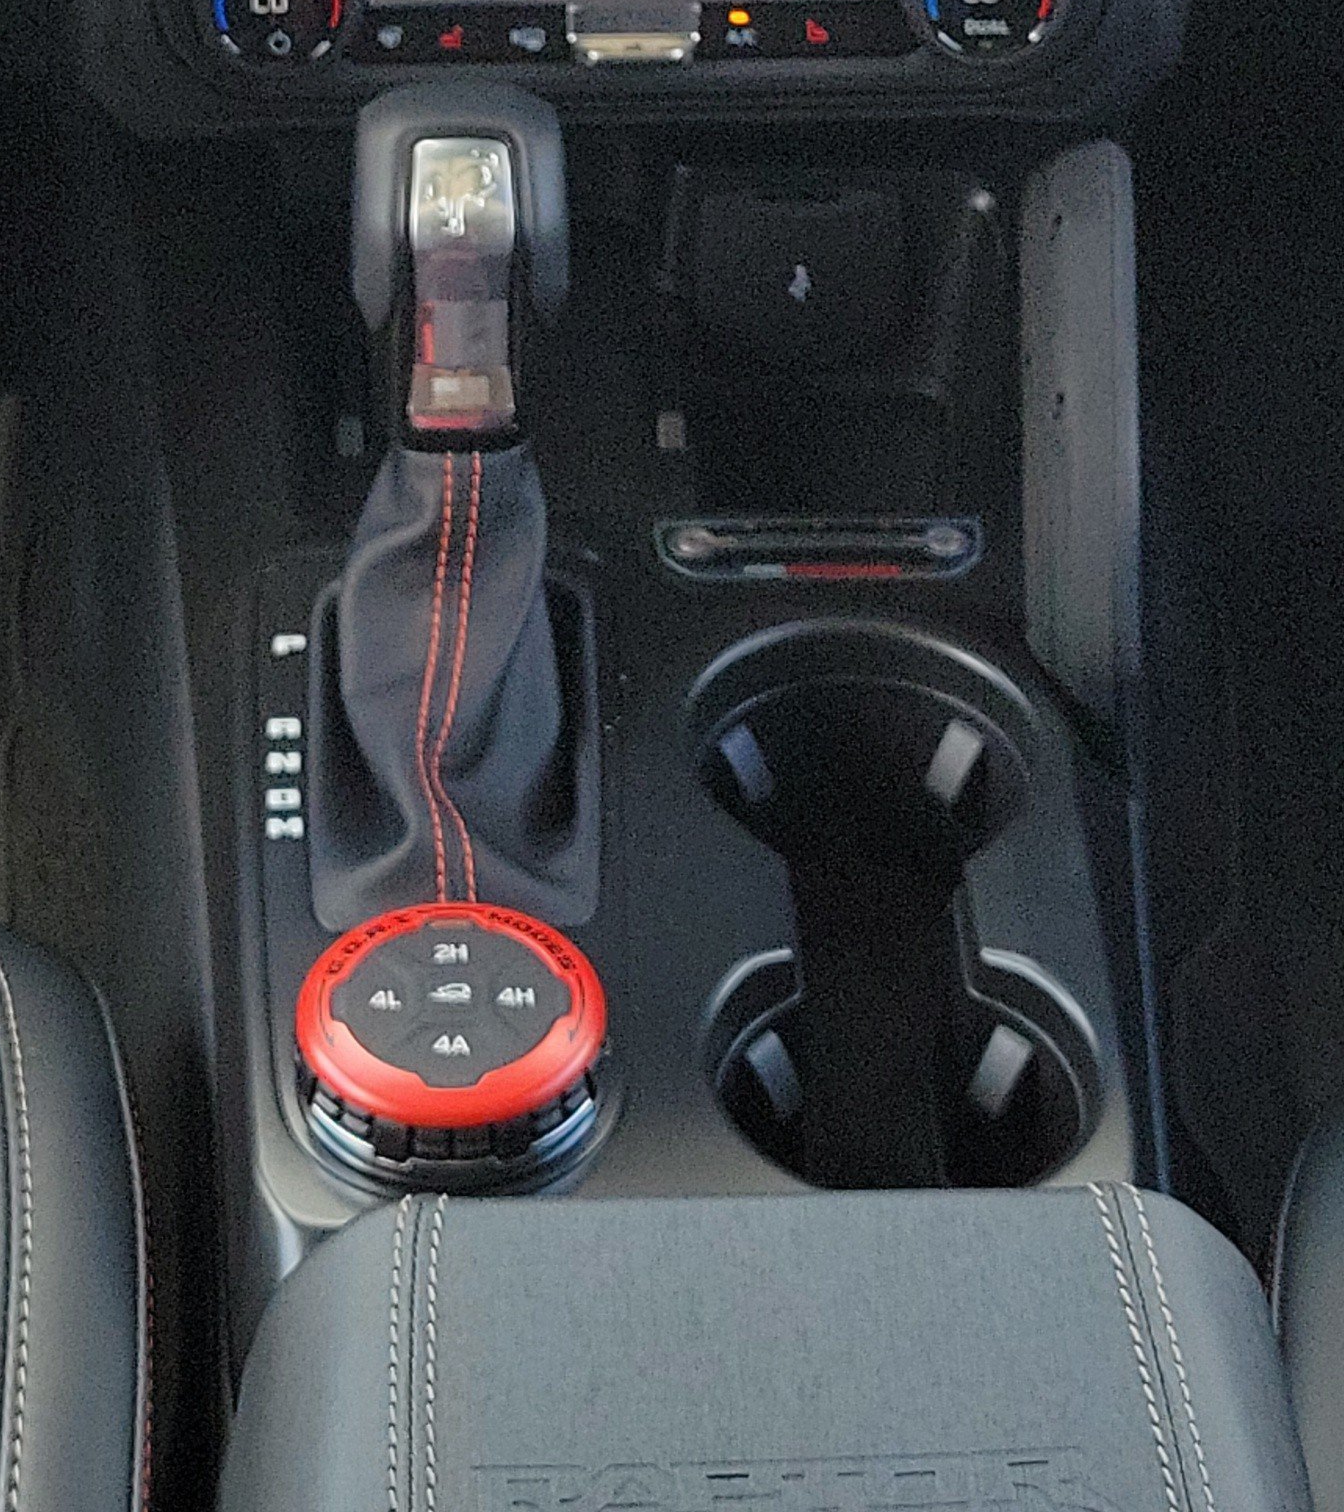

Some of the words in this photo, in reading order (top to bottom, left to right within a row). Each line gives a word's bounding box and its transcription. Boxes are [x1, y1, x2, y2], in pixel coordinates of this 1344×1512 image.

[488, 911, 576, 970] MODES
[432, 943, 470, 965] 2H
[368, 989, 403, 1011] 4L
[495, 986, 536, 1009] 4H
[431, 1034, 472, 1057] 4A
